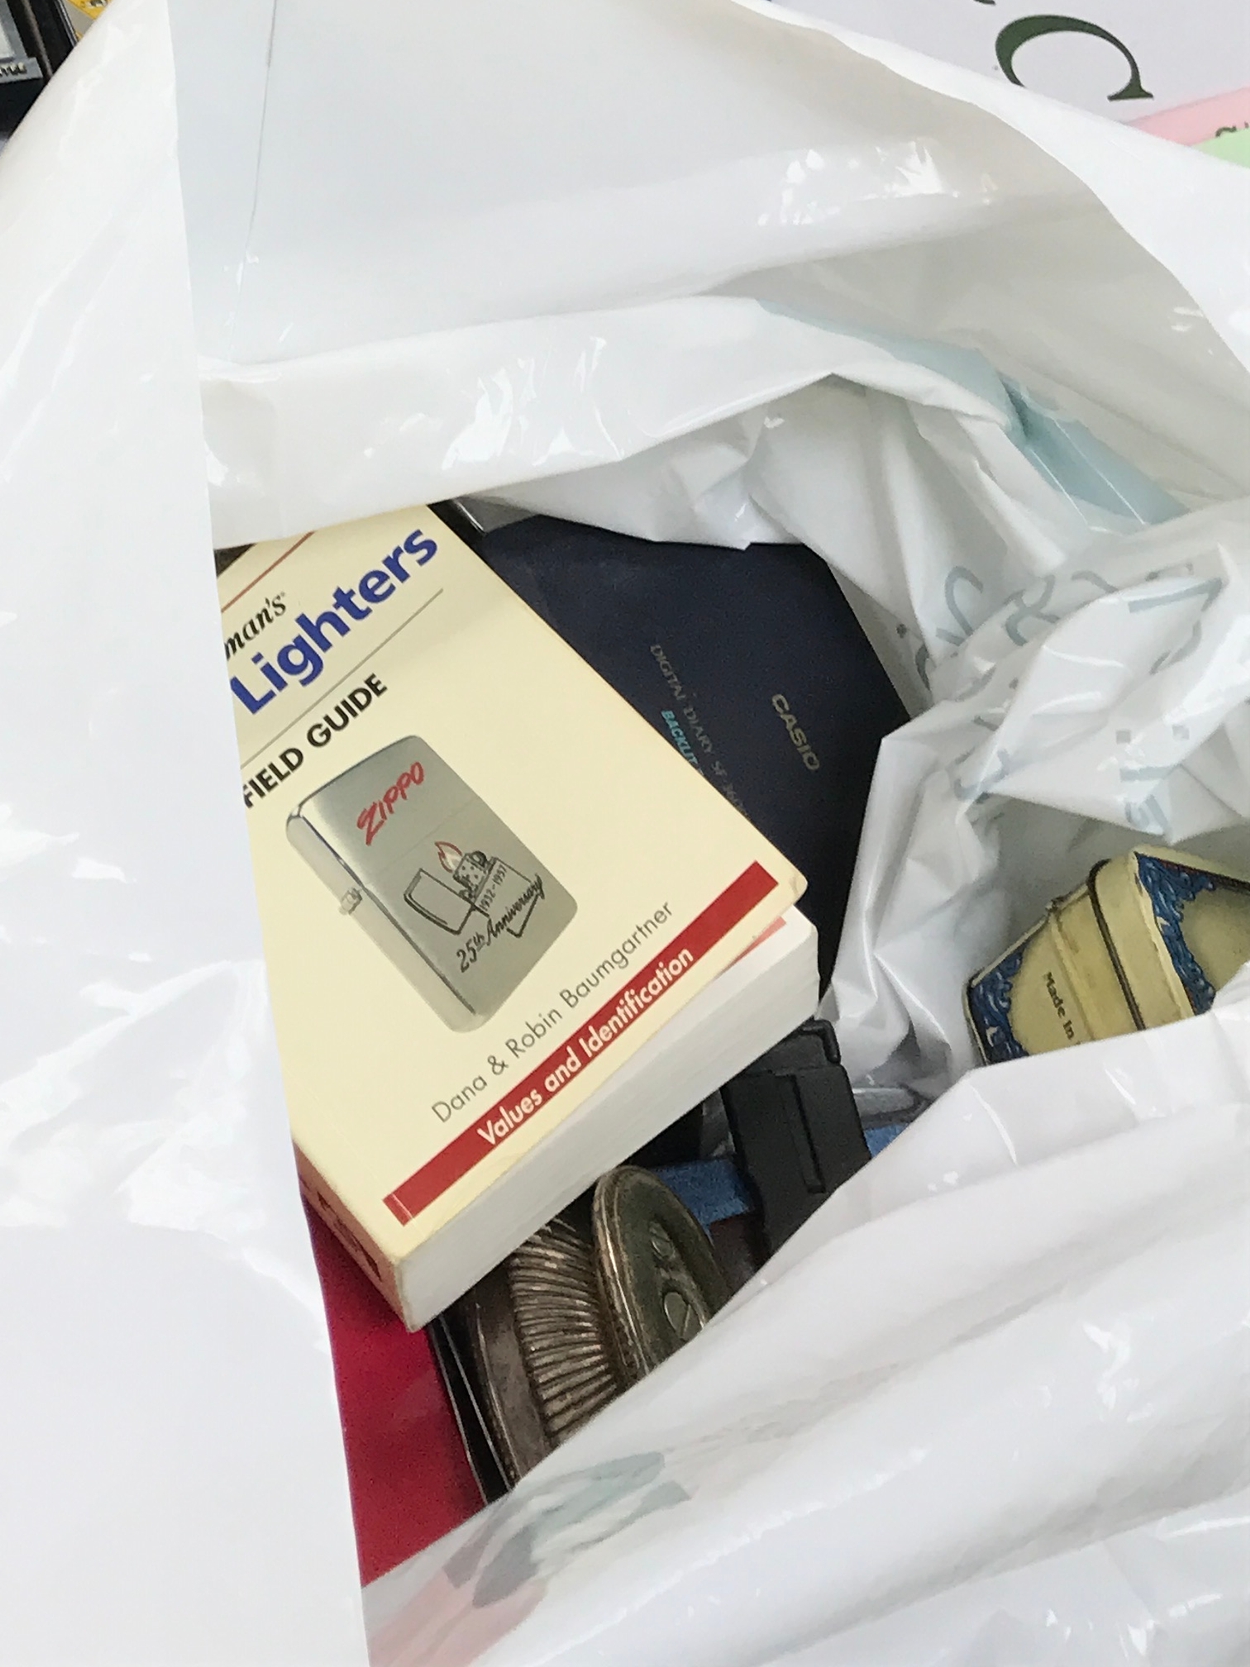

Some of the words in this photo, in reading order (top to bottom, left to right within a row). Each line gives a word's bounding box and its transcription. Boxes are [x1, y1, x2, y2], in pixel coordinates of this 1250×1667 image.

[230, 527, 438, 716] Lighters
[241, 746, 305, 810] FIELD
[305, 674, 388, 751] GUIDE
[679, 704, 718, 757] DIARY
[770, 693, 821, 773] CASIO
[354, 762, 427, 847] ZIPPO
[455, 939, 489, 974] 25th
[484, 875, 547, 948] Anniversary
[479, 864, 510, 915] 1932-1957
[430, 1077, 490, 1126] Dana
[486, 1053, 510, 1078] &
[505, 1008, 563, 1054] Robin
[557, 900, 674, 1014] Baumgartner
[1043, 971, 1069, 1019] Made
[478, 1089, 544, 1148] Values
[543, 1054, 583, 1094] and
[579, 948, 696, 1066] Identification
